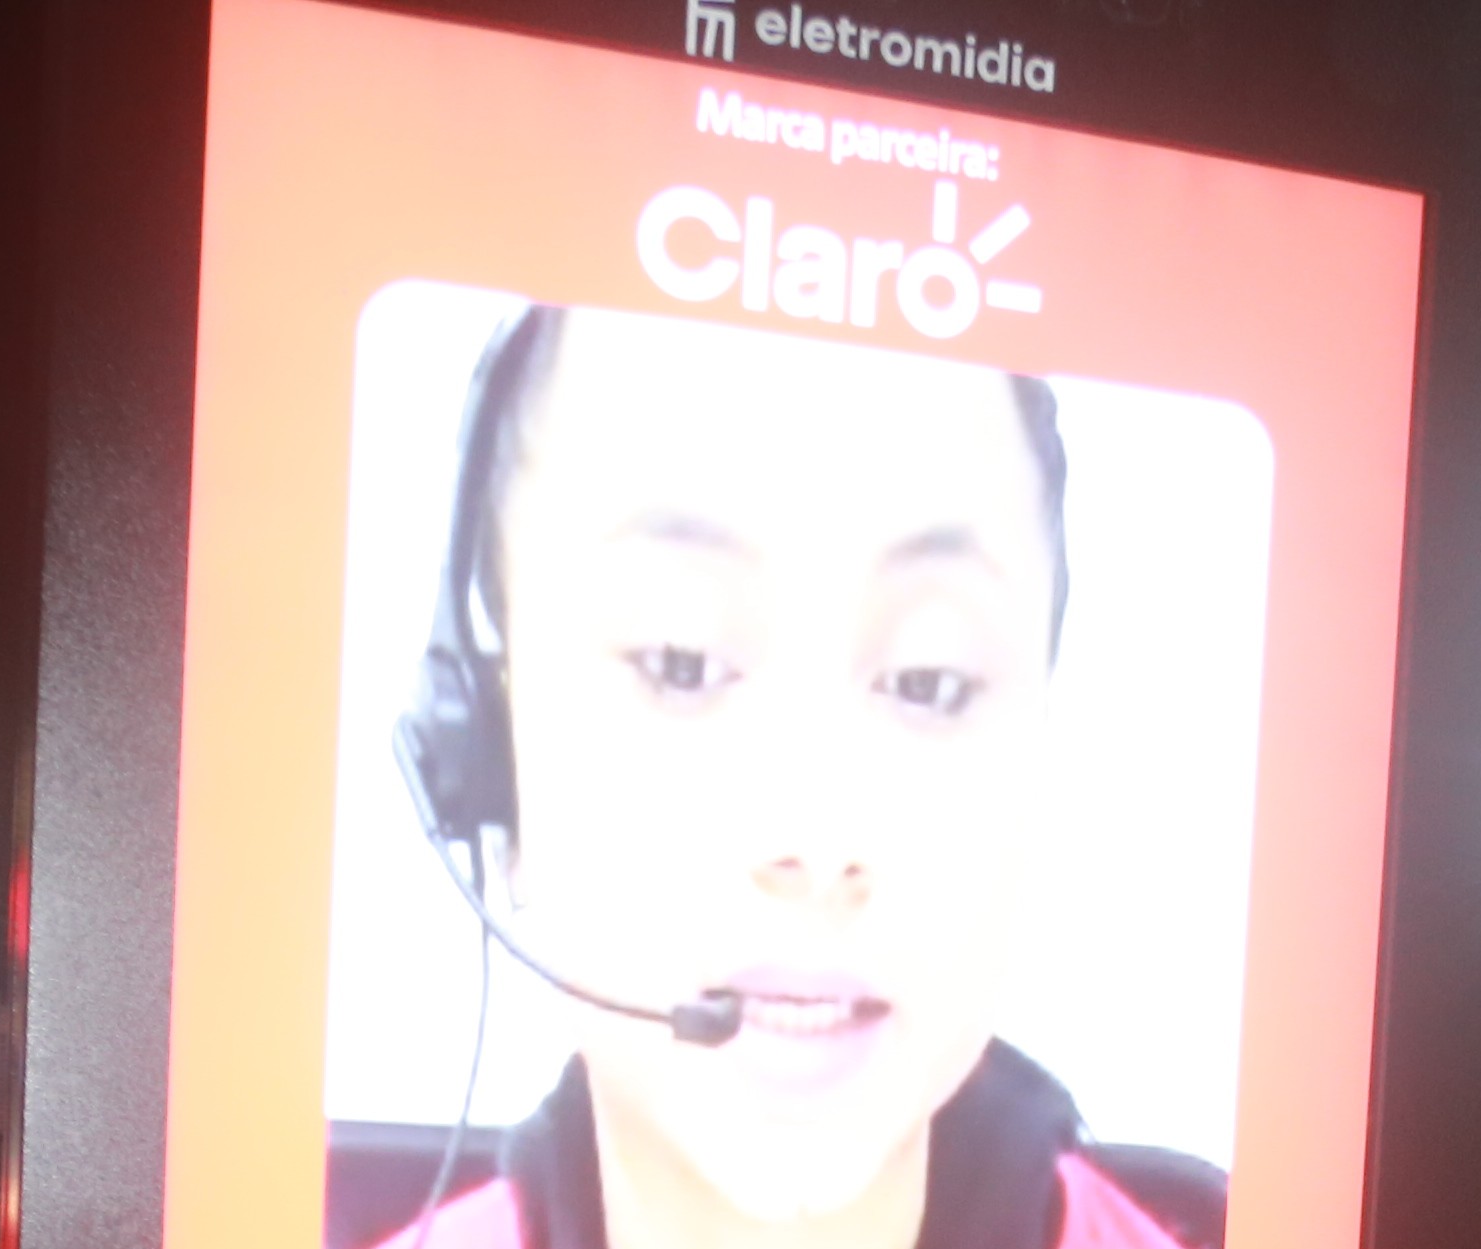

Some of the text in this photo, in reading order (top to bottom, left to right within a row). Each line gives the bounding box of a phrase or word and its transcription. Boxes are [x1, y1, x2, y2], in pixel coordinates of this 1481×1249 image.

[755, 2, 1056, 93] eletromidia
[696, 89, 1000, 182] Marca parceira:
[636, 181, 980, 339] Claro
